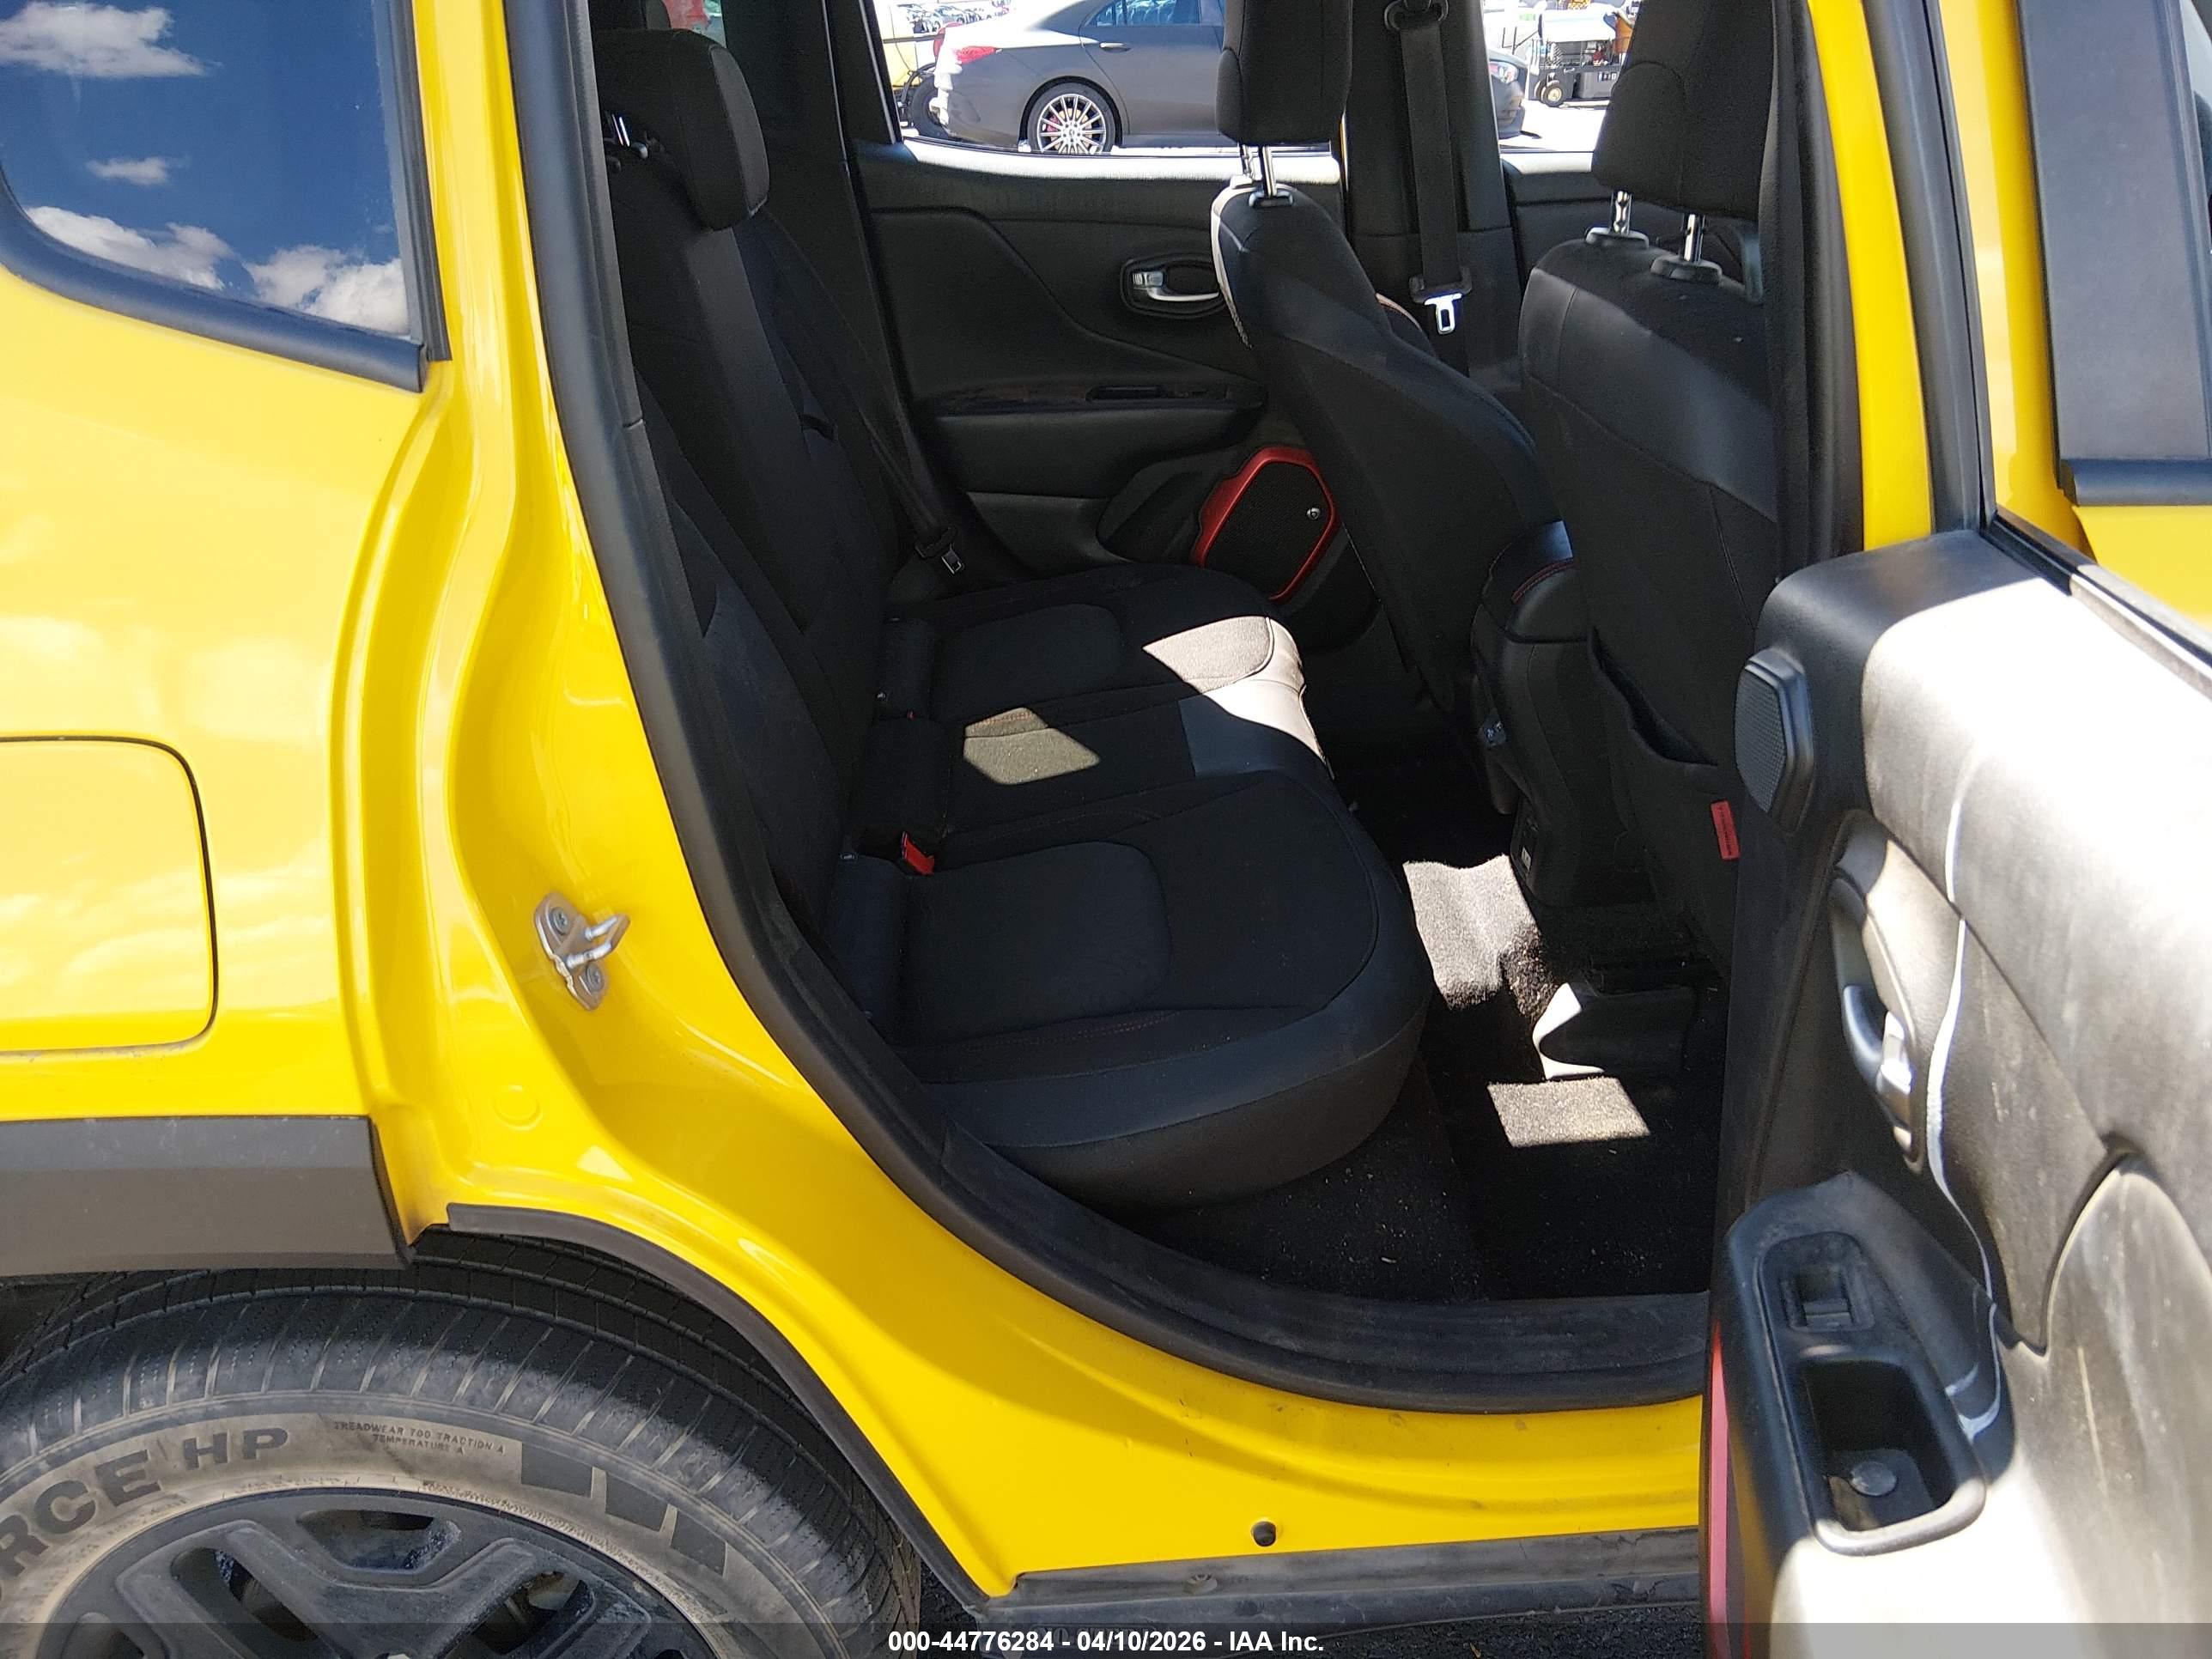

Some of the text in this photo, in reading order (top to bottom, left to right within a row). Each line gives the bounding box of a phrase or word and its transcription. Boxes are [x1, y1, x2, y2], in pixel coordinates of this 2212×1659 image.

[438, 1432, 494, 1451] TRACTION
[496, 1444, 505, 1455] A
[0, 1449, 161, 1582] RCE
[182, 1427, 289, 1471] HP
